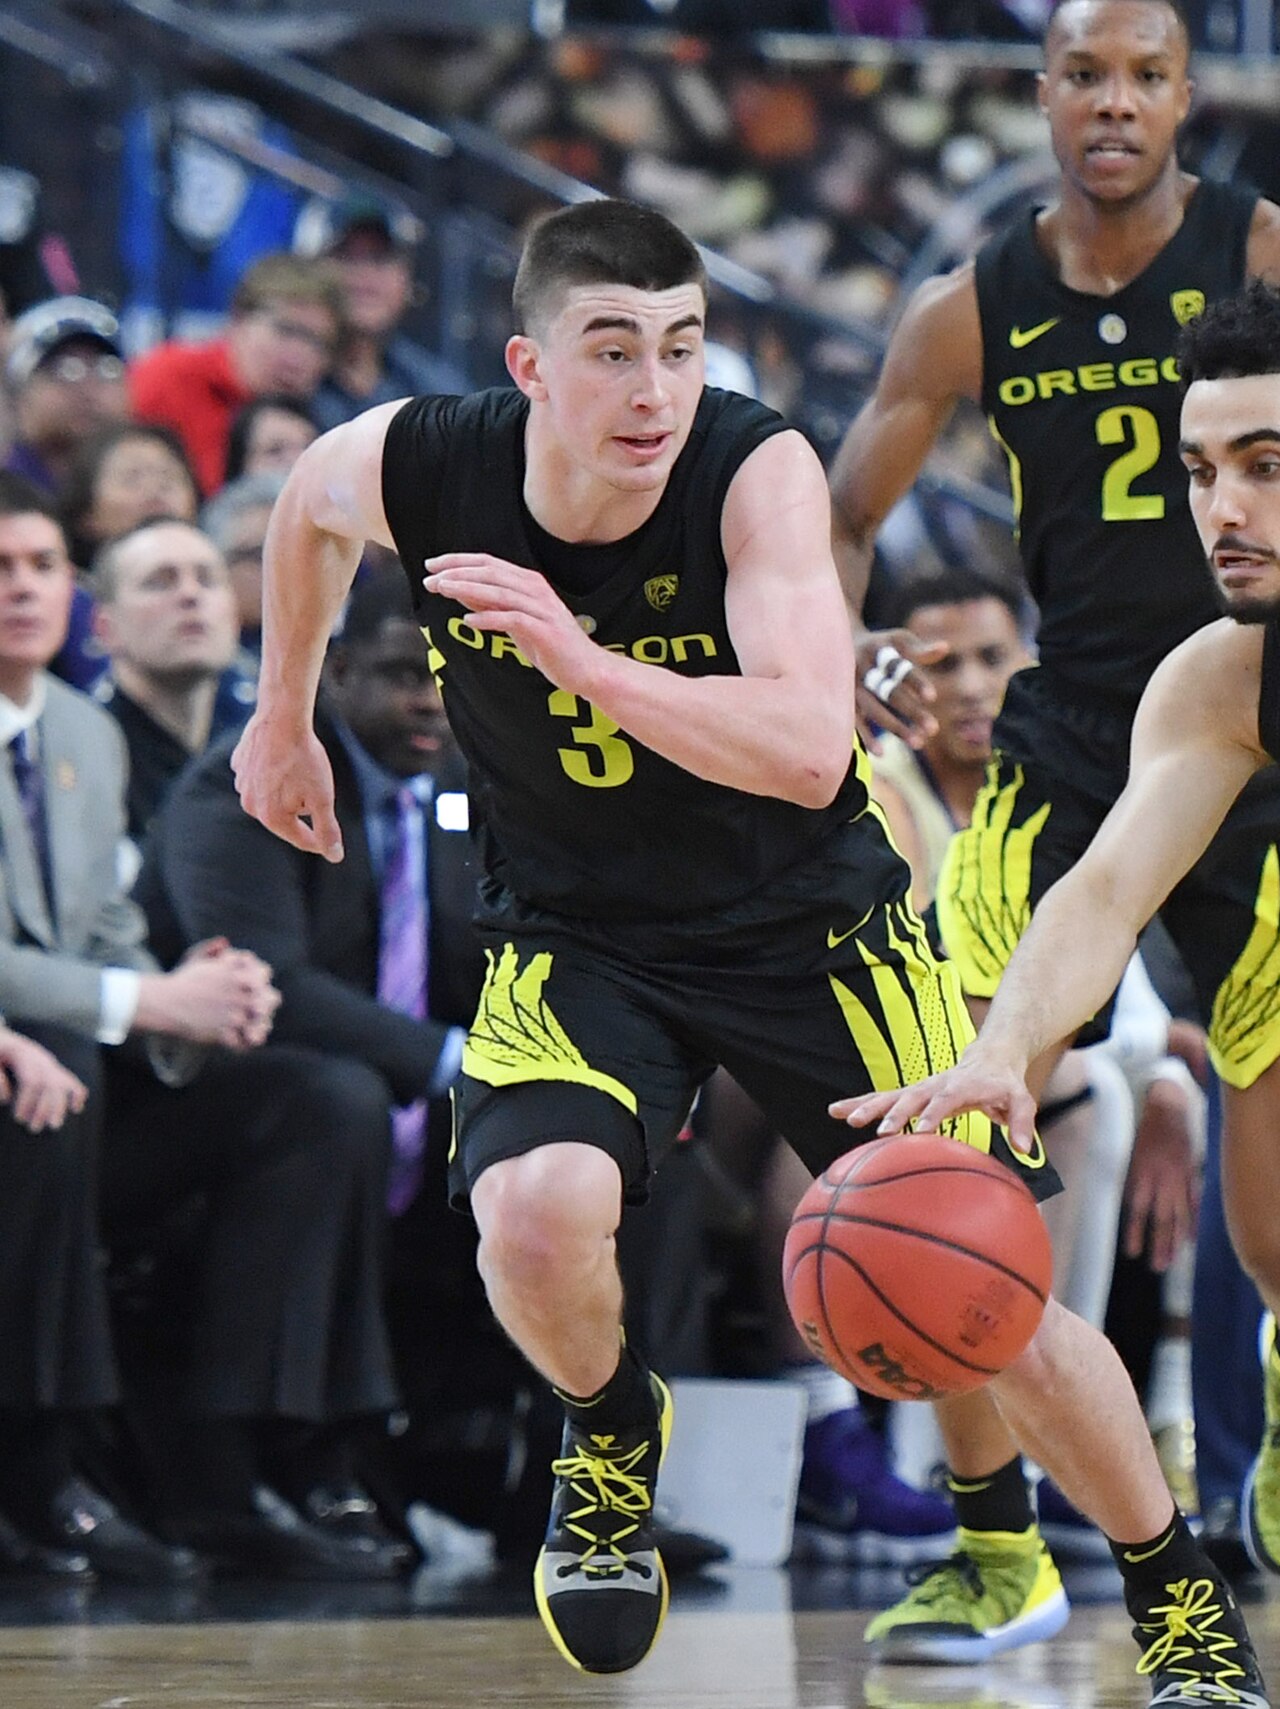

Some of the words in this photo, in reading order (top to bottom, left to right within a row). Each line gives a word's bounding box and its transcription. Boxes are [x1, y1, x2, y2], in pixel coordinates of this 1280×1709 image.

[1095, 404, 1165, 521] 2
[447, 617, 718, 668] ORON
[548, 688, 634, 788] 3
